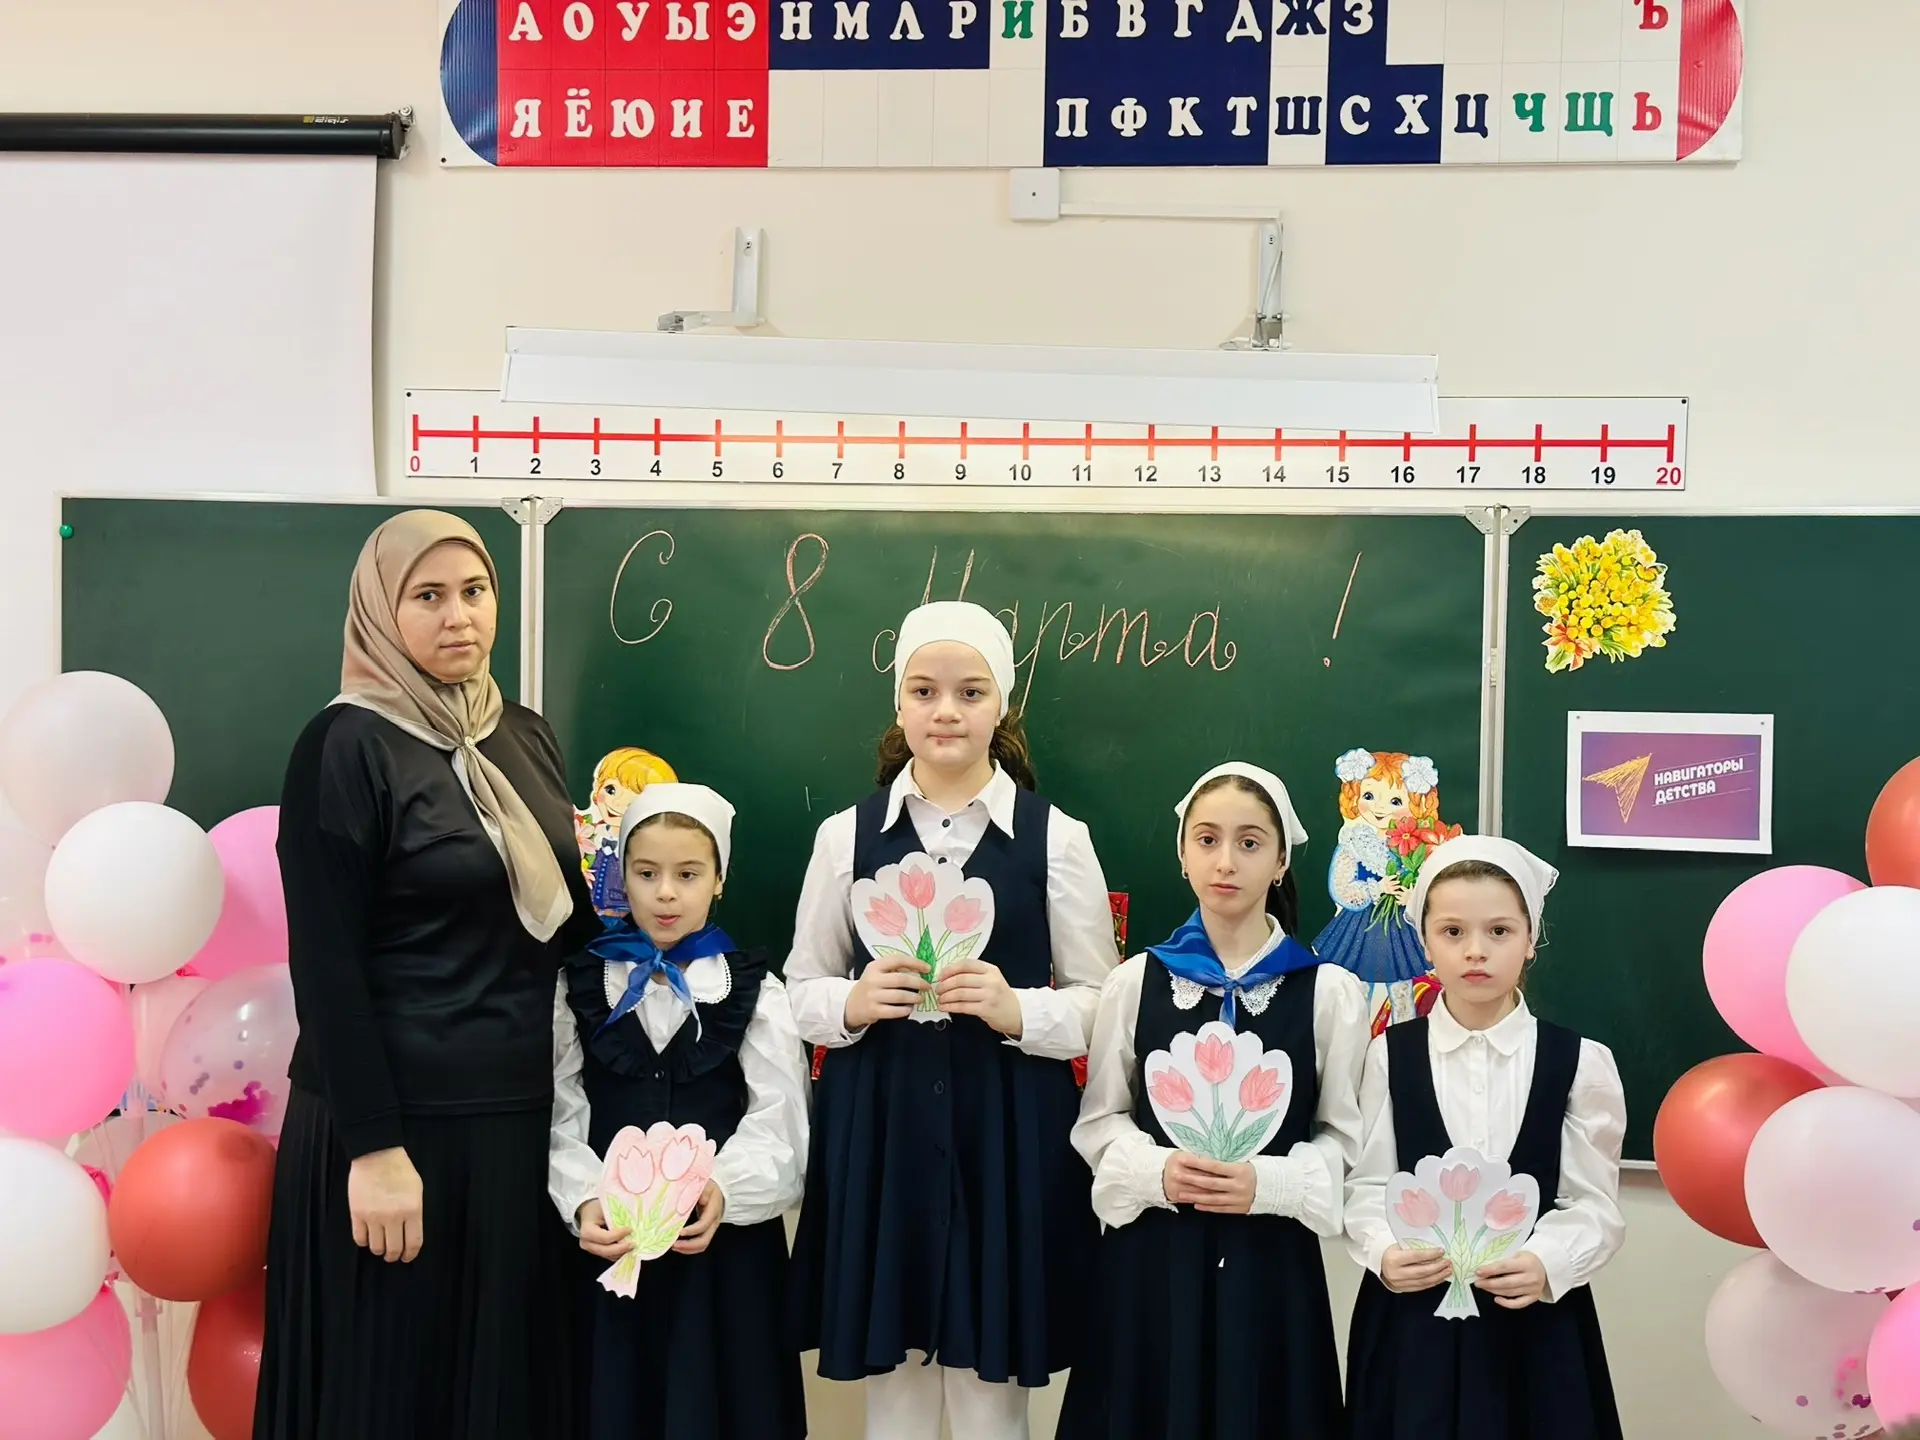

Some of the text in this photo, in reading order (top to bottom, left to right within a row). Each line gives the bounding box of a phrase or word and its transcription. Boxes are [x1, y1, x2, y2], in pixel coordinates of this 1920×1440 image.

[508, 1, 543, 41] А
[563, 1, 594, 41] О
[616, 1, 650, 42] У
[665, 1, 710, 41] Ы
[727, 1, 756, 41] Э
[779, 1, 813, 41] Н
[833, 1, 870, 41] М
[889, 0, 925, 41] Л
[948, 0, 977, 40] Р
[1059, 0, 1089, 38] Б
[1115, 0, 1147, 38] В
[1173, 0, 1204, 38] Г
[1226, 0, 1263, 43] Д
[1277, 0, 1326, 36] Ж
[1343, 0, 1374, 35] З
[509, 87, 1663, 139] Я Ё Ю И Е П Ф К Т Ш С Х Ц Ч Щ Ь
[409, 455, 1682, 486] 0 1 2 3 4 5 6 7 8 9 10 11 12 13 14 15 16 17 18 19 20
[610, 529, 675, 645] С
[763, 533, 829, 671] 8
[1654, 757, 1744, 786] НАВИГАТОРЫ
[1655, 780, 1716, 805] ДЕТСТВА
